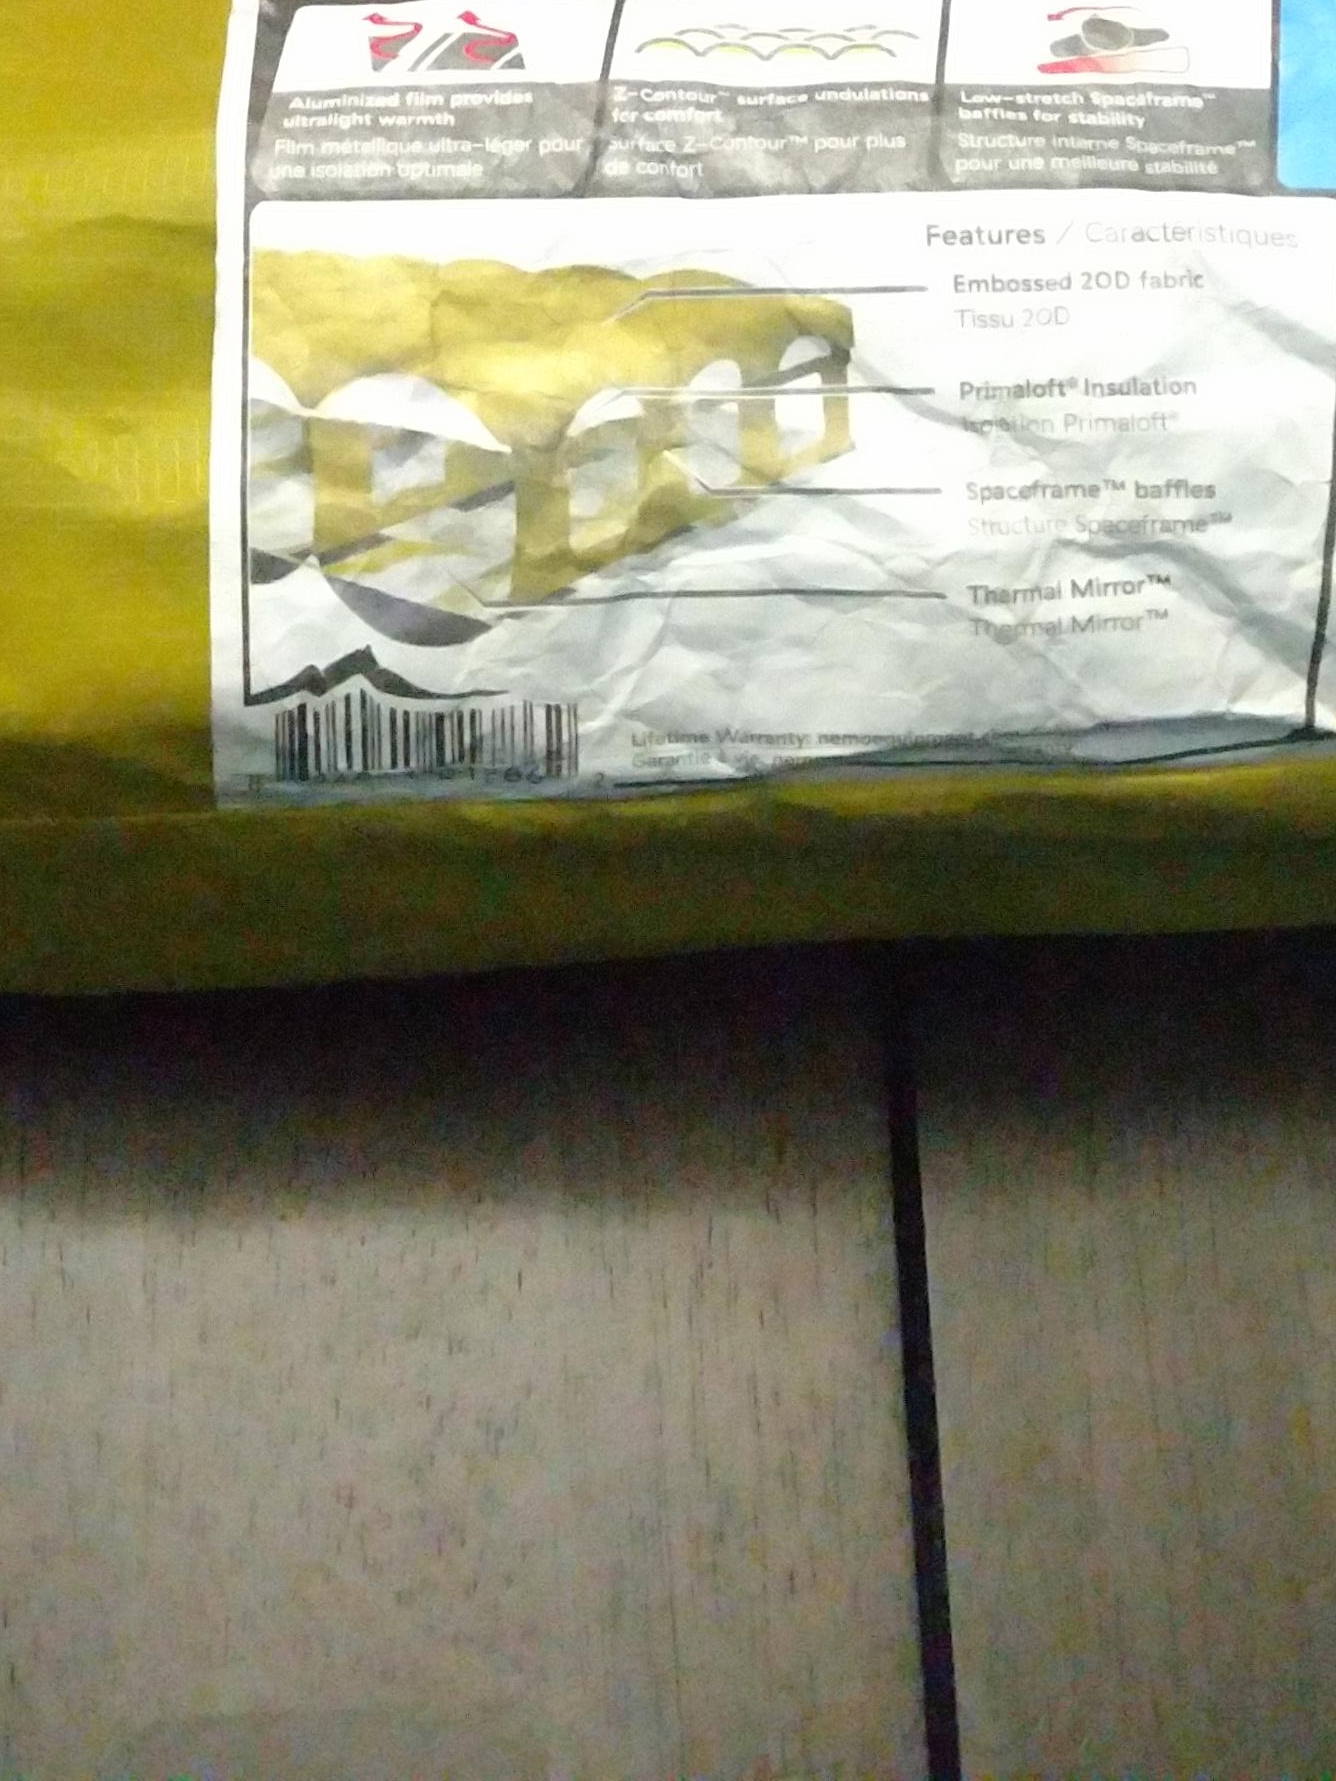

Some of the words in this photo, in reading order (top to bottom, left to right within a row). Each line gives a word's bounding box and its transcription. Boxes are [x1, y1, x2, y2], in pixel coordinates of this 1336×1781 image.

[406, 91, 444, 108] film
[450, 90, 533, 110] provides
[737, 91, 808, 106] surface
[815, 87, 930, 102] undulations
[283, 112, 371, 130] ultralight
[378, 111, 455, 127] warmth
[612, 108, 637, 123] for
[1033, 108, 1062, 123] for
[1068, 110, 1145, 128] stability
[275, 139, 314, 155] Film
[539, 138, 583, 156] pour
[815, 136, 857, 154] pour
[865, 134, 906, 152] plus
[636, 159, 703, 179] confort
[955, 156, 1000, 175] pour
[1008, 155, 1044, 171] une
[1050, 154, 1139, 172] meilleure
[926, 224, 1046, 247] Features
[953, 271, 1072, 294] Embossed
[1081, 271, 1130, 291] 20D
[1141, 267, 1205, 290] fabric
[954, 308, 1014, 329] Tissu
[1022, 306, 1069, 326] 20D
[1084, 377, 1197, 397] Insulation
[1134, 478, 1216, 500] baffles
[968, 516, 1065, 537] Structure
[967, 583, 1062, 606] Thermal
